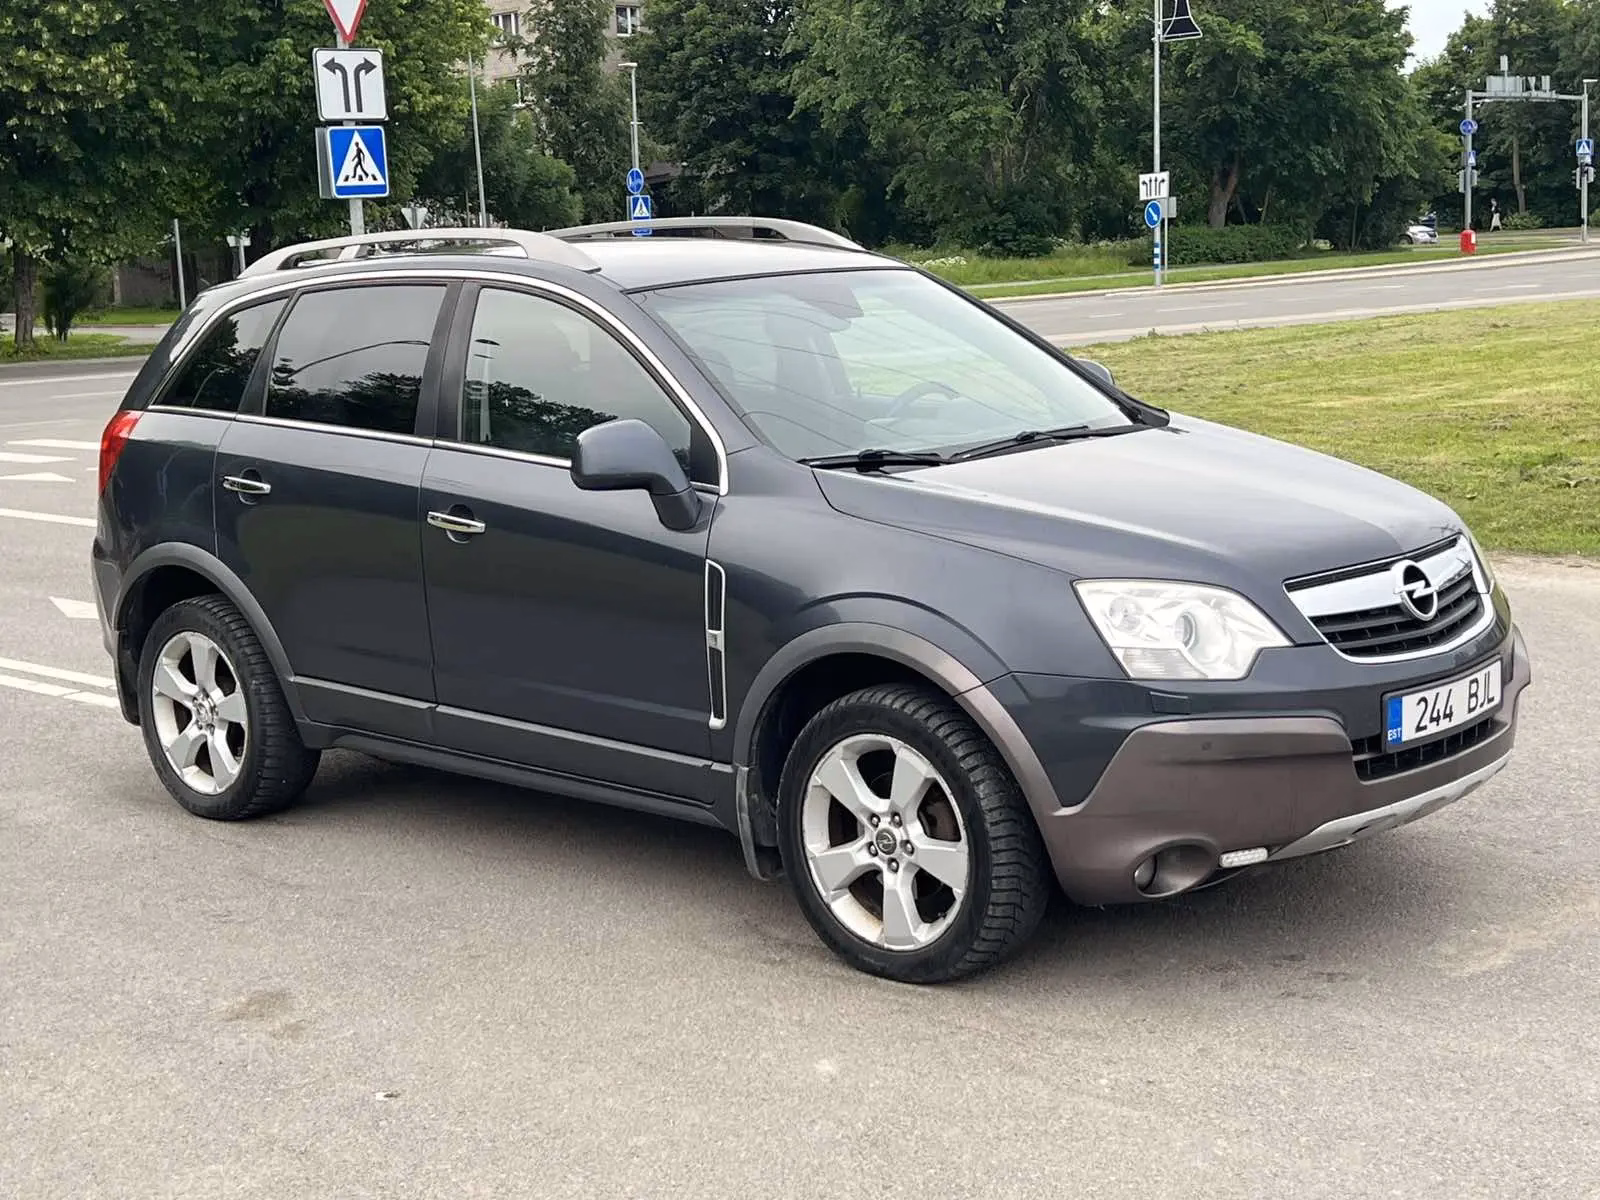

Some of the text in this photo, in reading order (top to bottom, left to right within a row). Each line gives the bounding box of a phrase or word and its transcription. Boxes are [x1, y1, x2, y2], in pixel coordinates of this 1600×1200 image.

[1415, 671, 1494, 733] 244 BJL
[1388, 728, 1402, 740] EST
